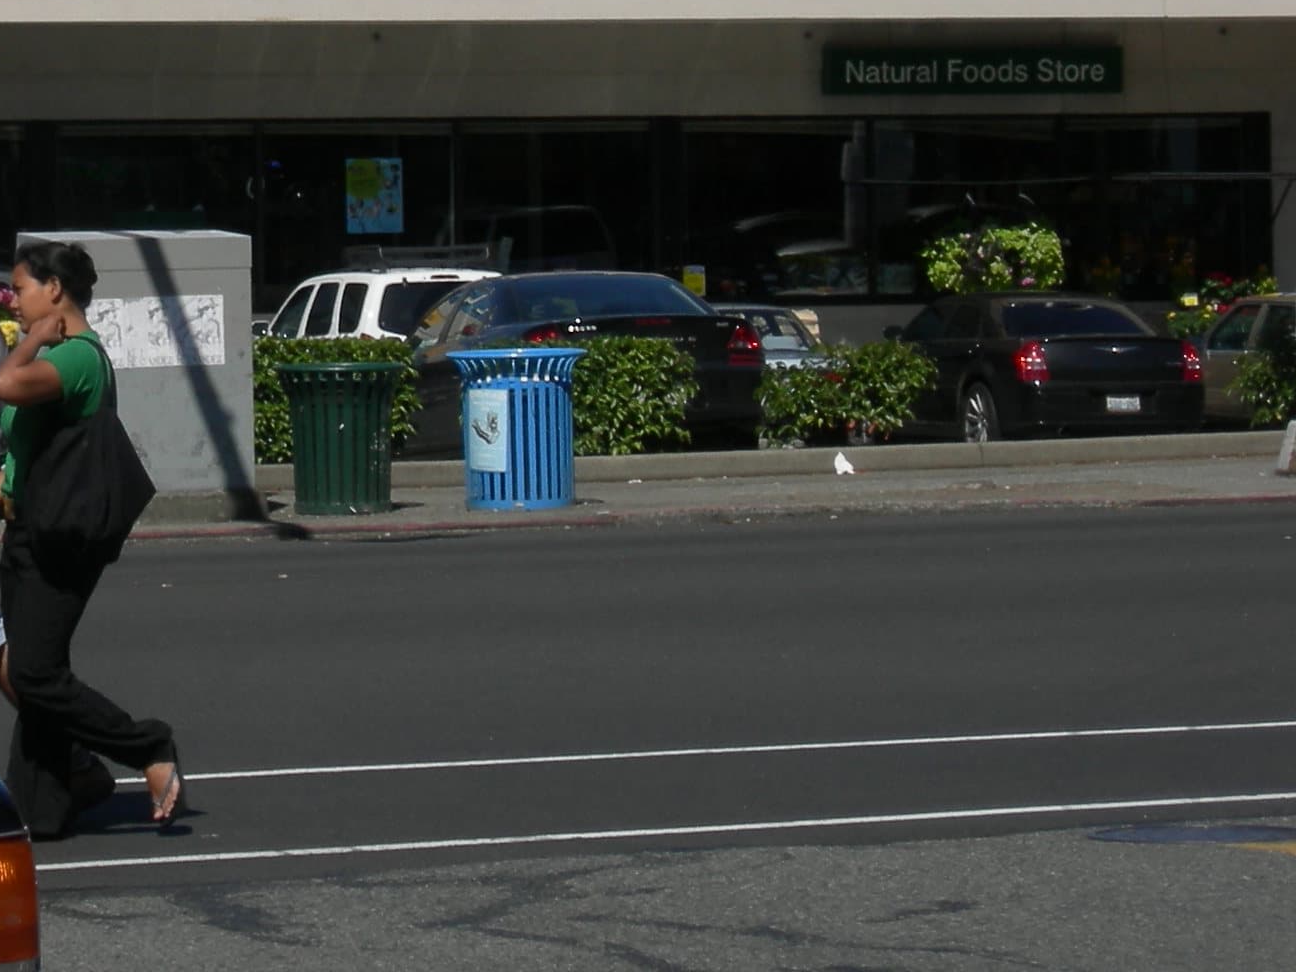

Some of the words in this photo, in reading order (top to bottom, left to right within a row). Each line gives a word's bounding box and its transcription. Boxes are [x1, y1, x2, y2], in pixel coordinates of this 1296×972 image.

[845, 59, 938, 84] Natural
[947, 59, 1028, 83] Foods
[1037, 58, 1105, 82] Store
